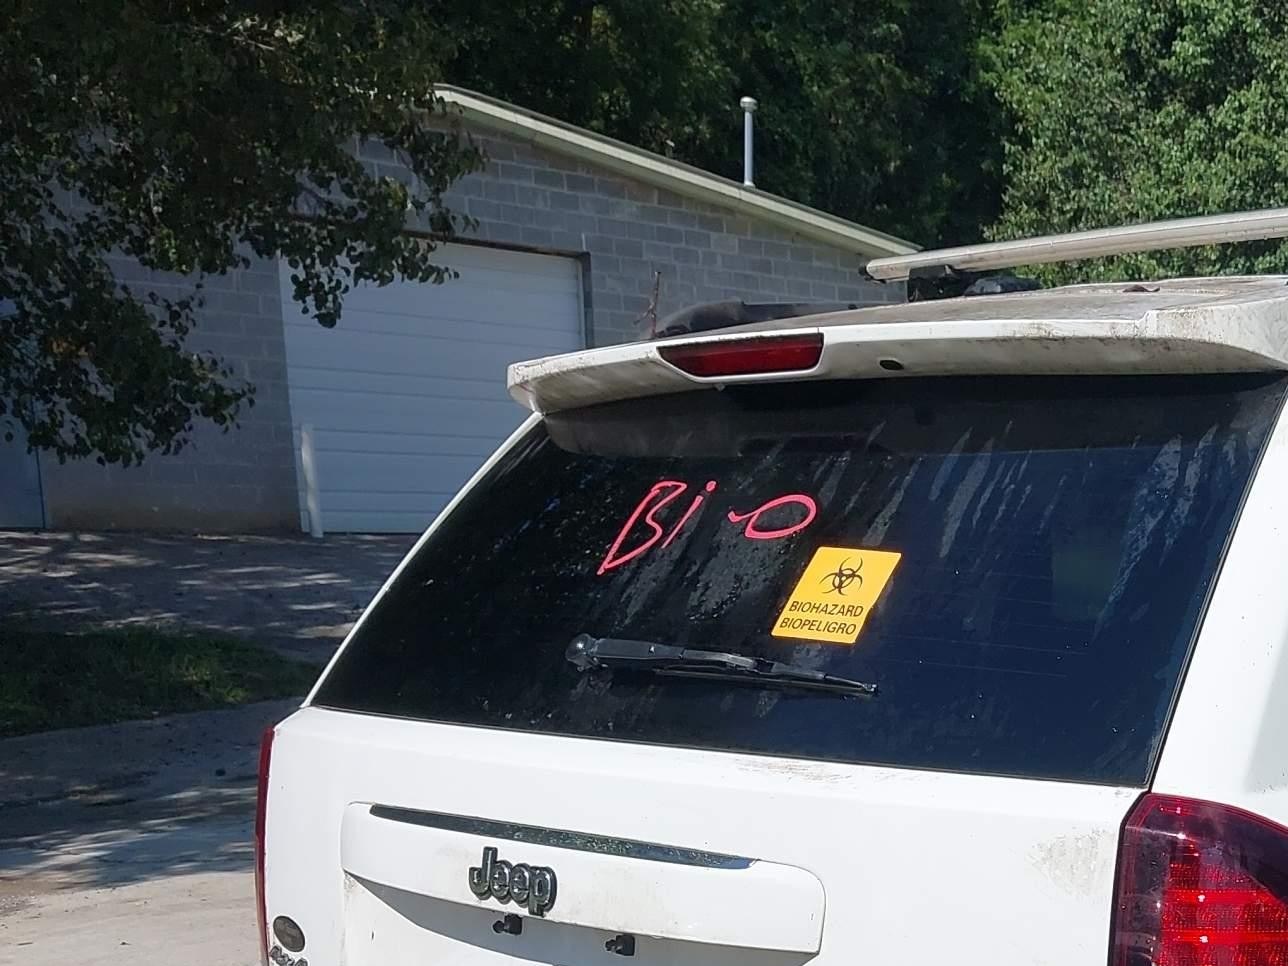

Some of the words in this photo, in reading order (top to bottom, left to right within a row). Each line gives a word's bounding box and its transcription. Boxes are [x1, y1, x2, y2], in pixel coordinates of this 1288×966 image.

[788, 600, 864, 617] BIOHAZARD
[779, 617, 857, 635] BIOPELIGRO
[469, 846, 557, 918] Jeep
